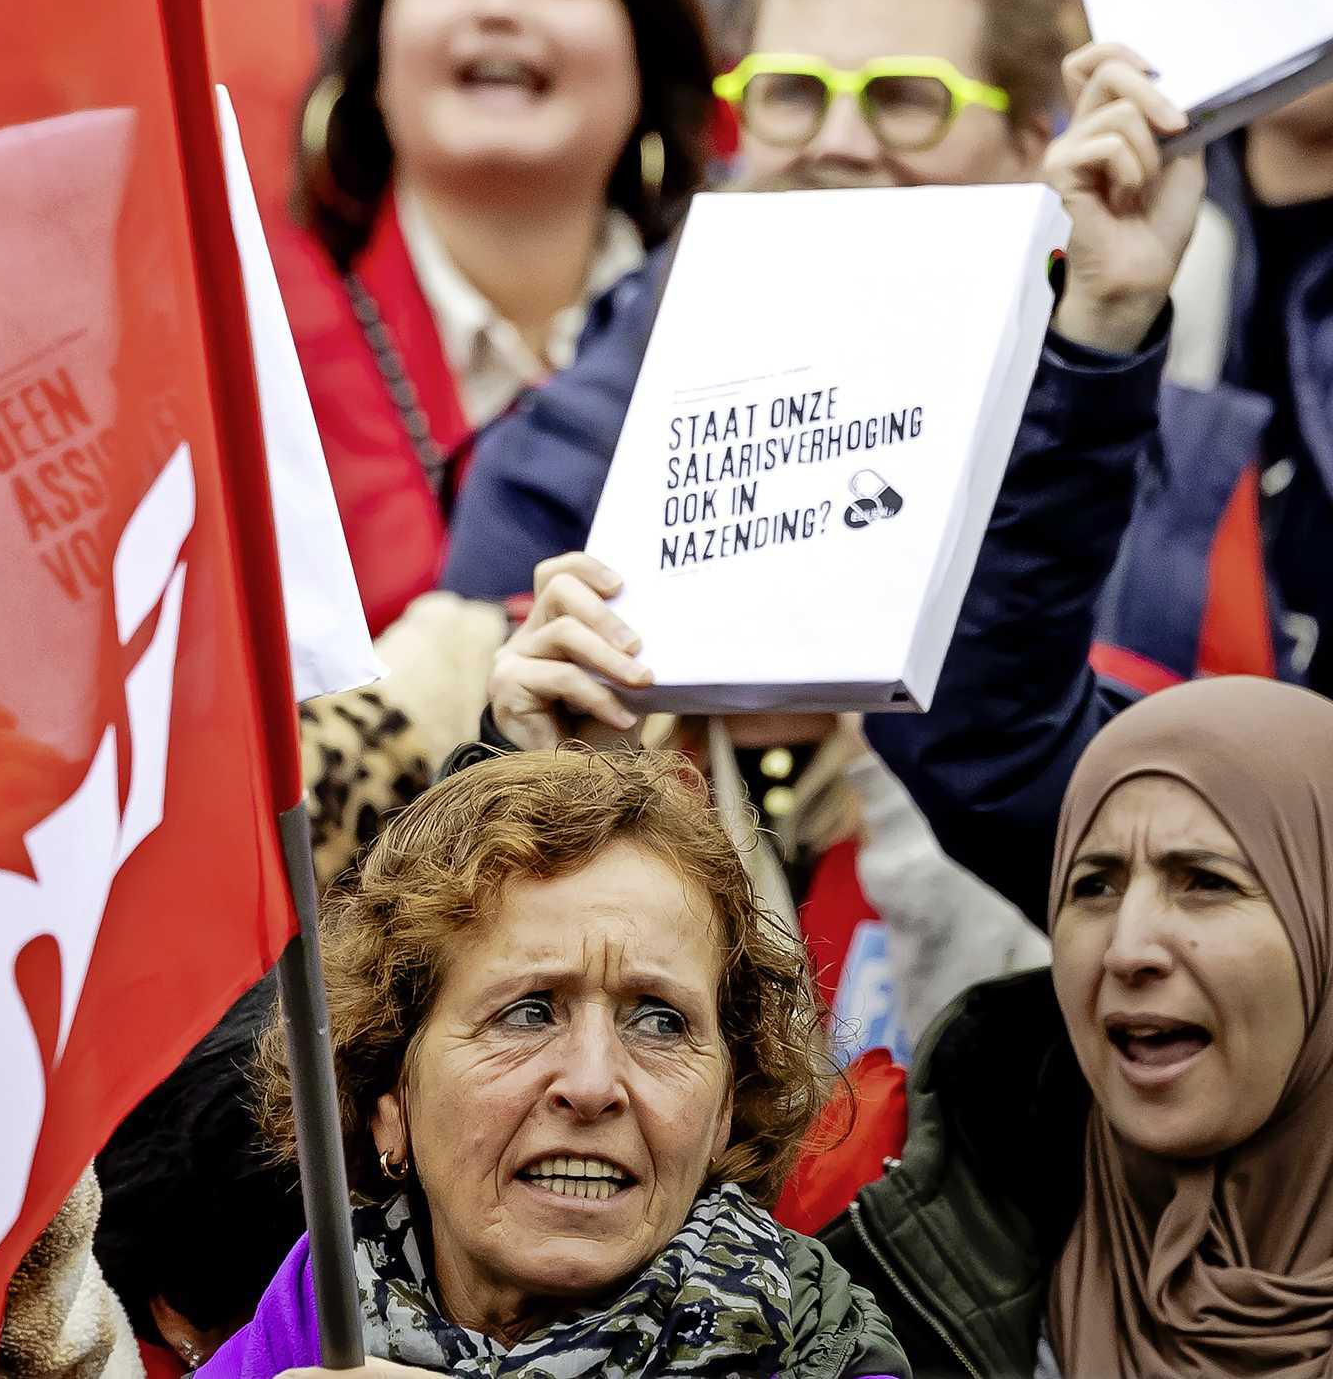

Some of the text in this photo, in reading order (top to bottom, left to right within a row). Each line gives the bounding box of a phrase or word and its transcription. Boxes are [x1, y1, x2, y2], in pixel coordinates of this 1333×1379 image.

[667, 406, 923, 489] SALARISVERHOGING
[669, 387, 838, 451] STAAT ONZE
[660, 501, 831, 570] NAZENDING?
[665, 481, 757, 527] OOK IN
[39, 530, 105, 601] VO
